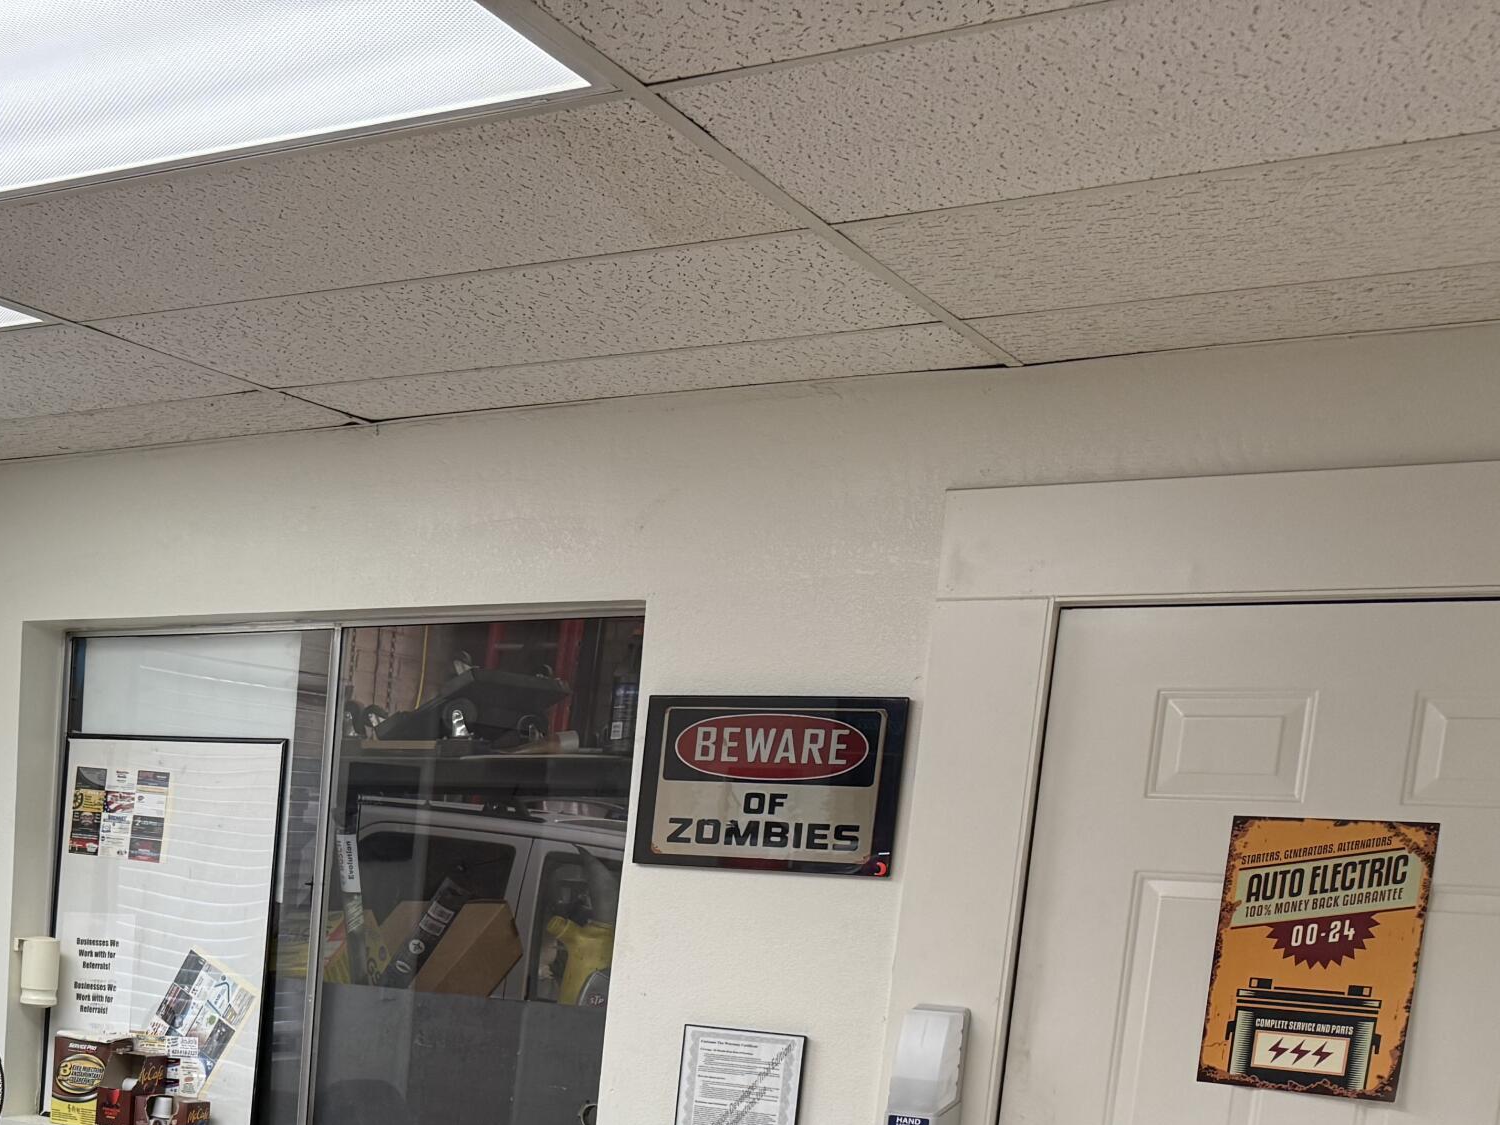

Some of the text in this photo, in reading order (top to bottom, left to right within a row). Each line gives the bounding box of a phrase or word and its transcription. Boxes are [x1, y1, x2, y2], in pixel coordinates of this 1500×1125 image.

[694, 726, 850, 765] BEWARE
[743, 792, 788, 815] OF
[666, 817, 860, 852] ZOMBIES
[346, 841, 355, 880] Evolution
[1241, 836, 1393, 865] STARTERS, GENERATORS, ALTERNATORS
[1245, 854, 1409, 903] AUTO ELECTRIC
[1245, 888, 1404, 918] 100% MONEY BACK GUARANTEE
[76, 937, 119, 948] Businesses We
[1291, 920, 1356, 947] 00-24
[78, 949, 116, 959] Work with for
[82, 961, 111, 970] Referrals!
[74, 981, 117, 992] Businesses We
[76, 993, 113, 1003] Work with for
[80, 1004, 108, 1014] Referrals!
[1255, 1018, 1354, 1035] COMPLETE SERVICE AND PARTS
[896, 1116, 921, 1125] HAND
